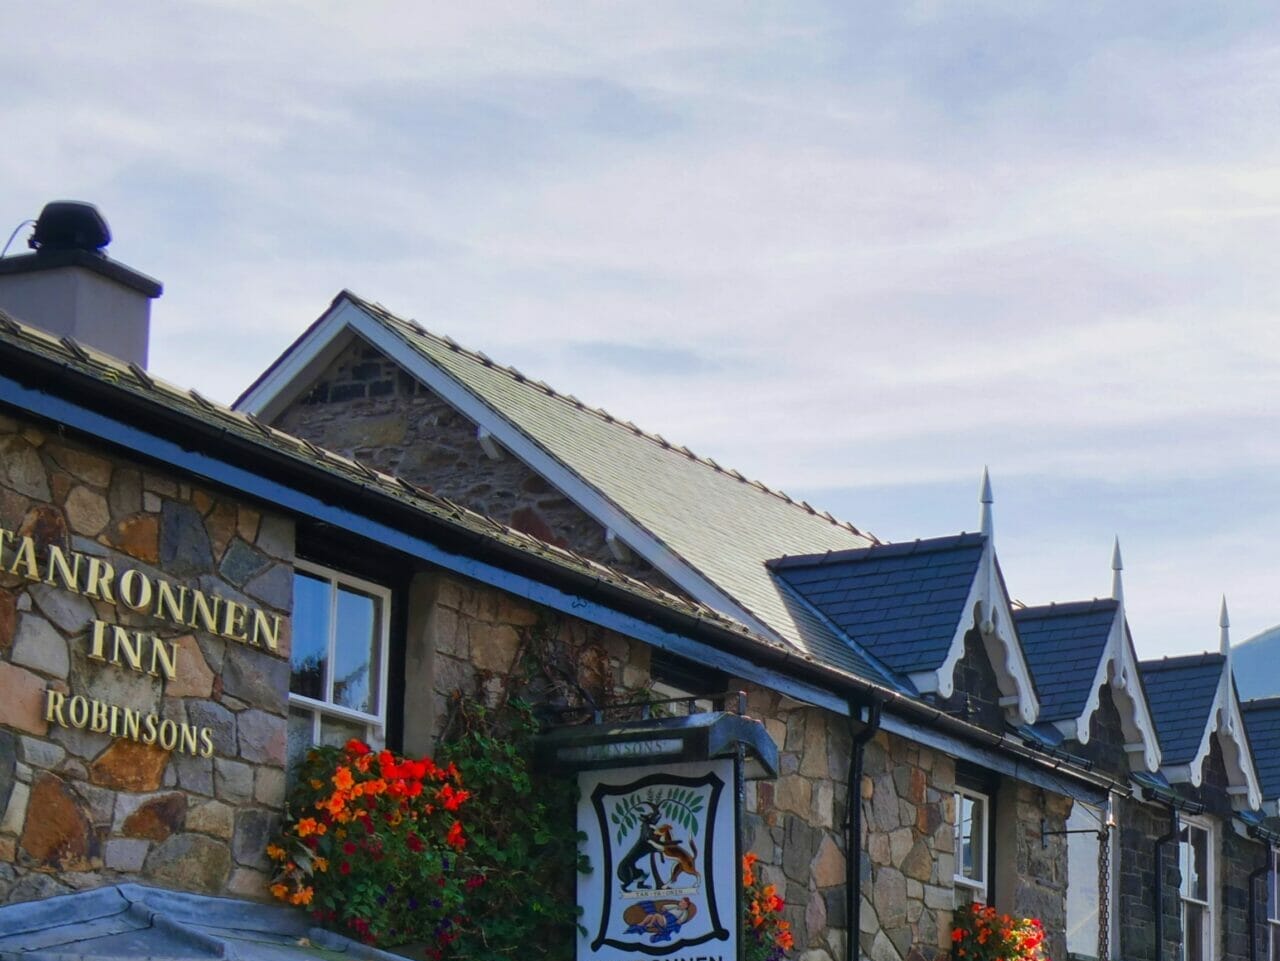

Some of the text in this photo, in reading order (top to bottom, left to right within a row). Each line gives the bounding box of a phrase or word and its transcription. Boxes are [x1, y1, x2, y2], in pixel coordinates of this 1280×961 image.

[0, 528, 282, 652] TANRONNEN
[88, 618, 181, 682] INN
[44, 688, 214, 758] ROBINSONS
